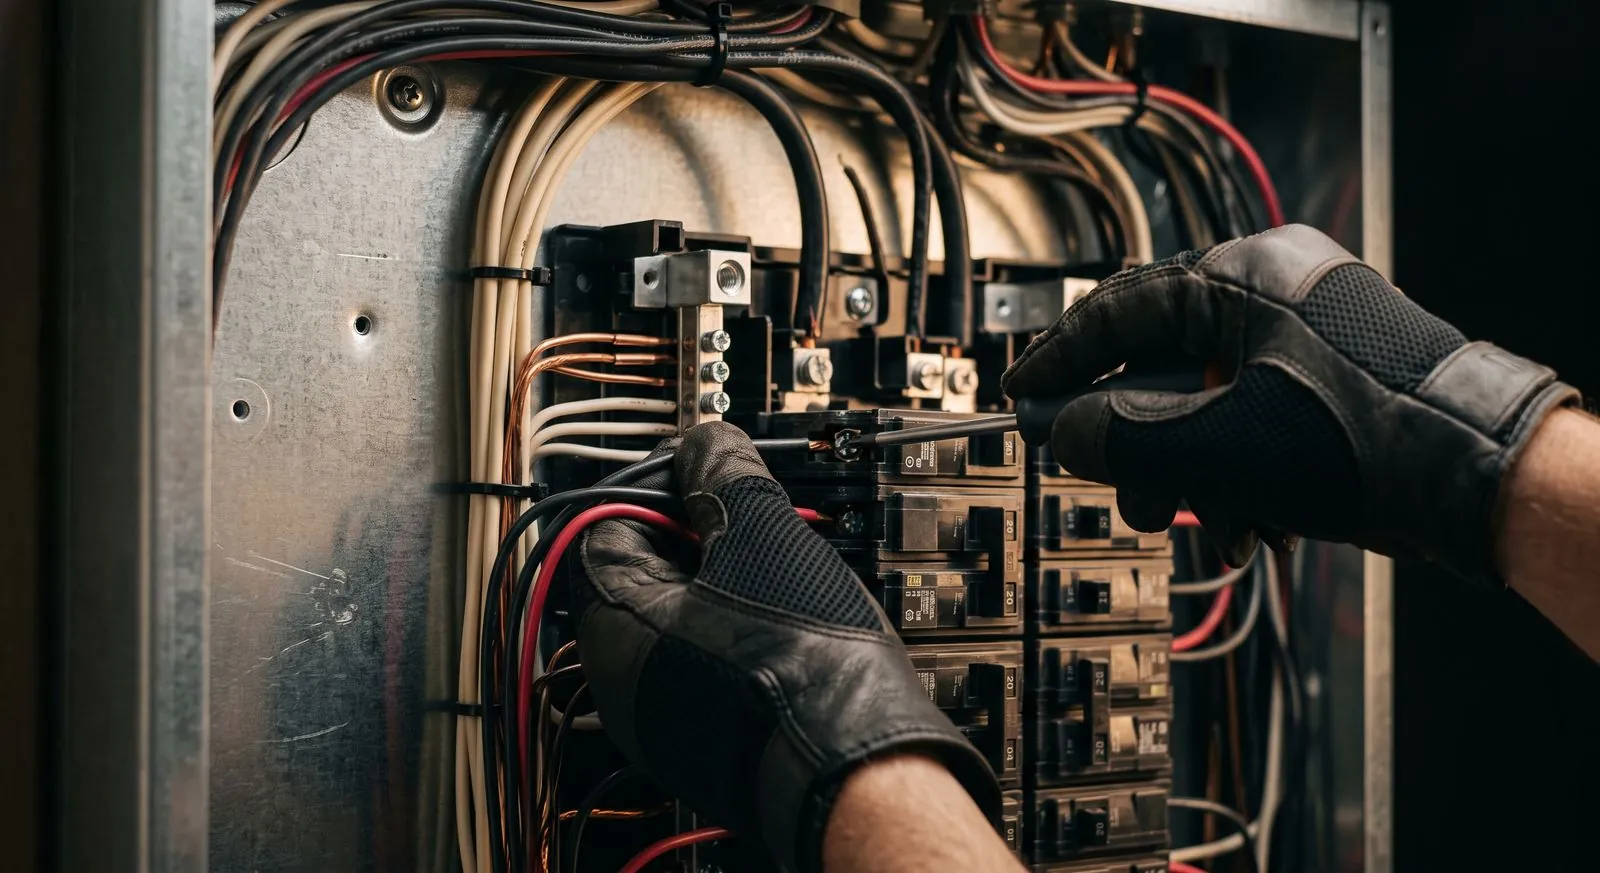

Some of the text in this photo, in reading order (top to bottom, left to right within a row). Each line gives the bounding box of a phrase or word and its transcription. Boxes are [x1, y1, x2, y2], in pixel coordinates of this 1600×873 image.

[1006, 519, 1014, 534] 20
[1006, 590, 1014, 606] 20
[1006, 675, 1014, 690] 20
